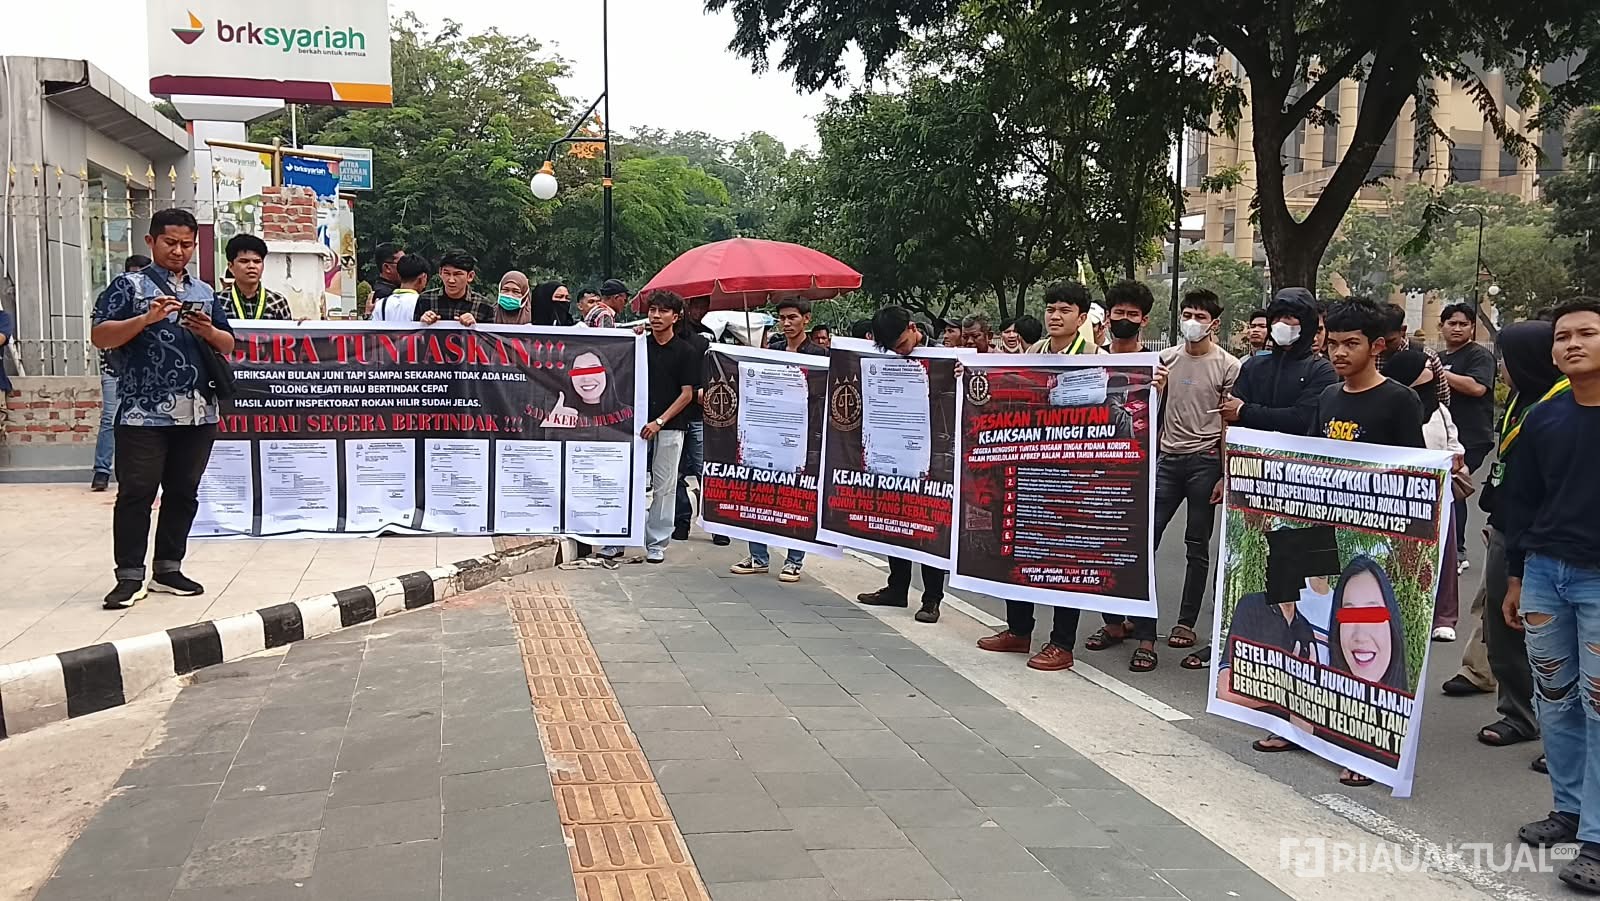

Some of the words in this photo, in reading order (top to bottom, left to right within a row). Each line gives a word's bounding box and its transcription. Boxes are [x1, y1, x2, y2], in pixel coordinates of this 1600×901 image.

[217, 19, 365, 52] brksyariah
[288, 370, 320, 380] BULAN
[322, 370, 344, 380] JUNI
[346, 370, 366, 380] TAPI
[368, 370, 402, 380] SAMPAI
[404, 370, 452, 380] SEKARANG
[454, 371, 480, 380] TIDAK
[482, 372, 501, 381] ADA
[502, 372, 527, 382] HASIL
[270, 384, 308, 394] TOLONG
[310, 384, 341, 394] KEJATI
[344, 384, 366, 394] RIAU
[368, 384, 419, 393] BERTINDAK
[421, 384, 448, 393] CEPAT
[234, 399, 262, 408] HASIL
[264, 399, 293, 408] AUDIT
[296, 399, 360, 408] INSPEKTORAT
[362, 398, 394, 407] ROKAN
[396, 398, 420, 406] HILIR
[422, 398, 451, 407] SUDAH
[453, 399, 482, 408] JELAS.
[254, 414, 302, 432] RIAU
[306, 414, 386, 432] SEGERA
[392, 412, 499, 432] BERTINDAK
[554, 414, 591, 428] KEBAL
[592, 406, 634, 426] HUKUM
[970, 412, 1031, 430] DESAKAN
[1036, 407, 1110, 426] TUNTUTAN
[978, 427, 1042, 444] KEJAKSAAN
[1044, 426, 1082, 442] TINGGI
[1087, 425, 1116, 438] RIAU
[1084, 442, 1106, 450] PIDANA
[702, 461, 749, 480] KEJARI
[752, 468, 796, 486] ROKAN
[704, 477, 748, 490] TERLALU
[832, 468, 875, 488] KEJARI
[878, 476, 920, 494] ROKAN
[924, 480, 954, 498] HILIR
[1230, 456, 1262, 478] OKNUM
[1264, 460, 1284, 480] PNS
[1285, 462, 1370, 492] MENGGELAPKAN
[1372, 472, 1404, 497] DANA
[1406, 476, 1437, 501] DESA
[730, 490, 747, 500] PNS
[750, 492, 774, 504] YANG
[836, 486, 872, 499] TERLALU
[1230, 477, 1254, 493] NOMOR
[1256, 480, 1276, 496] SURAT
[1276, 482, 1326, 503] INSPEKTORAT
[1326, 490, 1376, 511] KABUPATEN
[1376, 496, 1406, 516] ROKAN
[1408, 500, 1432, 520] HILIR
[858, 499, 874, 511] PNS
[876, 500, 901, 514] YANG
[1030, 574, 1044, 582] TAPI
[1082, 576, 1100, 584] ATAS
[1235, 640, 1283, 668] SETELAH
[1285, 655, 1317, 684] KEBAL
[1320, 668, 1366, 700] HUKUM
[1234, 656, 1294, 690] KERJASAMA
[1296, 674, 1337, 706] DENGAN
[1340, 694, 1378, 726] MAFIA
[1233, 672, 1287, 707] BERKEDOK
[1288, 690, 1326, 726] DENGAN
[1329, 709, 1391, 751] KELOMPOK
